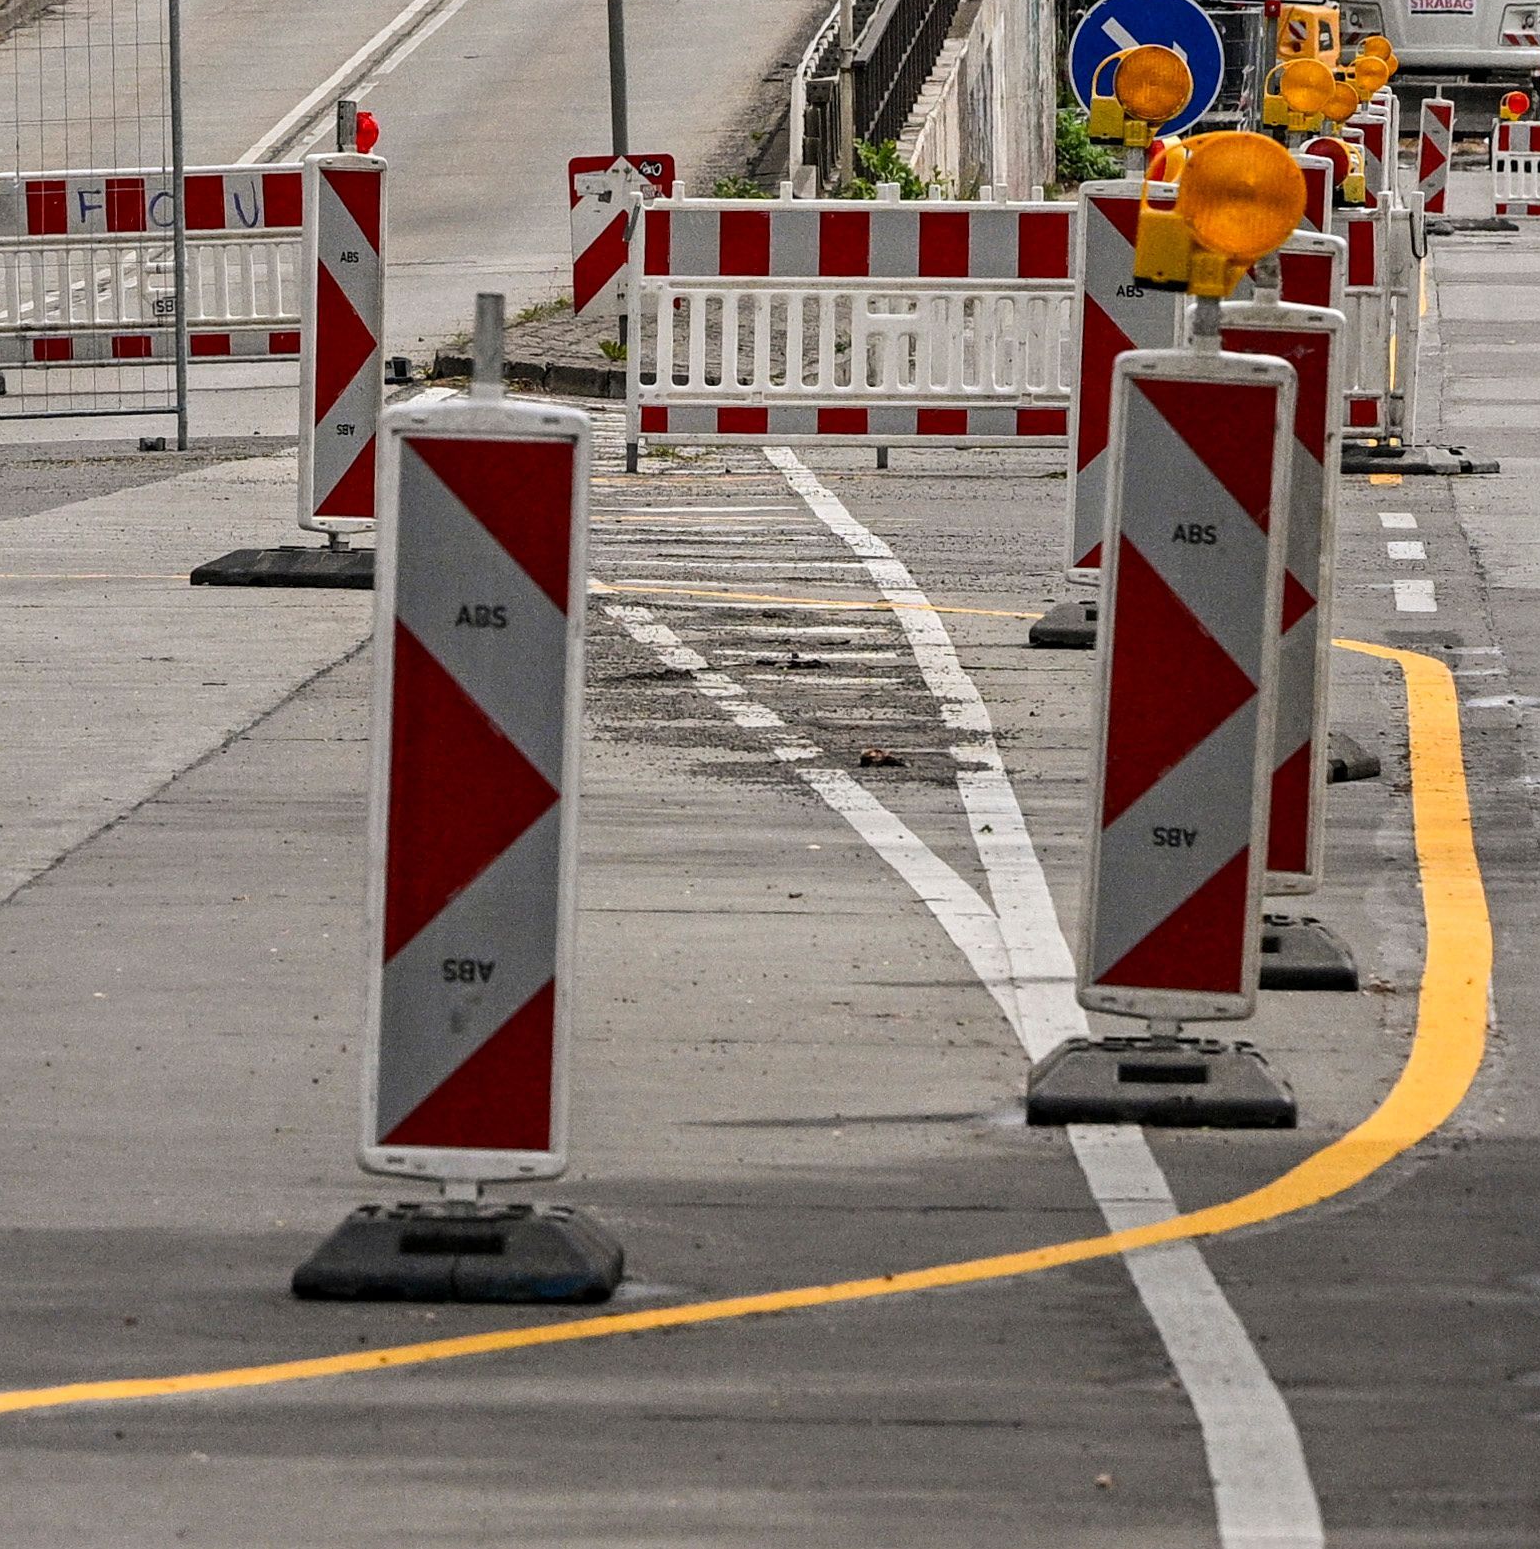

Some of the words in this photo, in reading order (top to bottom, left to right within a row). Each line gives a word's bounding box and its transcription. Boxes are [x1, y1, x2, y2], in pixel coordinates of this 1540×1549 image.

[340, 251, 359, 264] ABS
[1116, 284, 1144, 298] ABS
[336, 423, 356, 436] ABS
[1171, 523, 1217, 546] ABS
[455, 603, 508, 629] ABS
[1152, 826, 1199, 848] ABS
[442, 958, 497, 984] ABS
